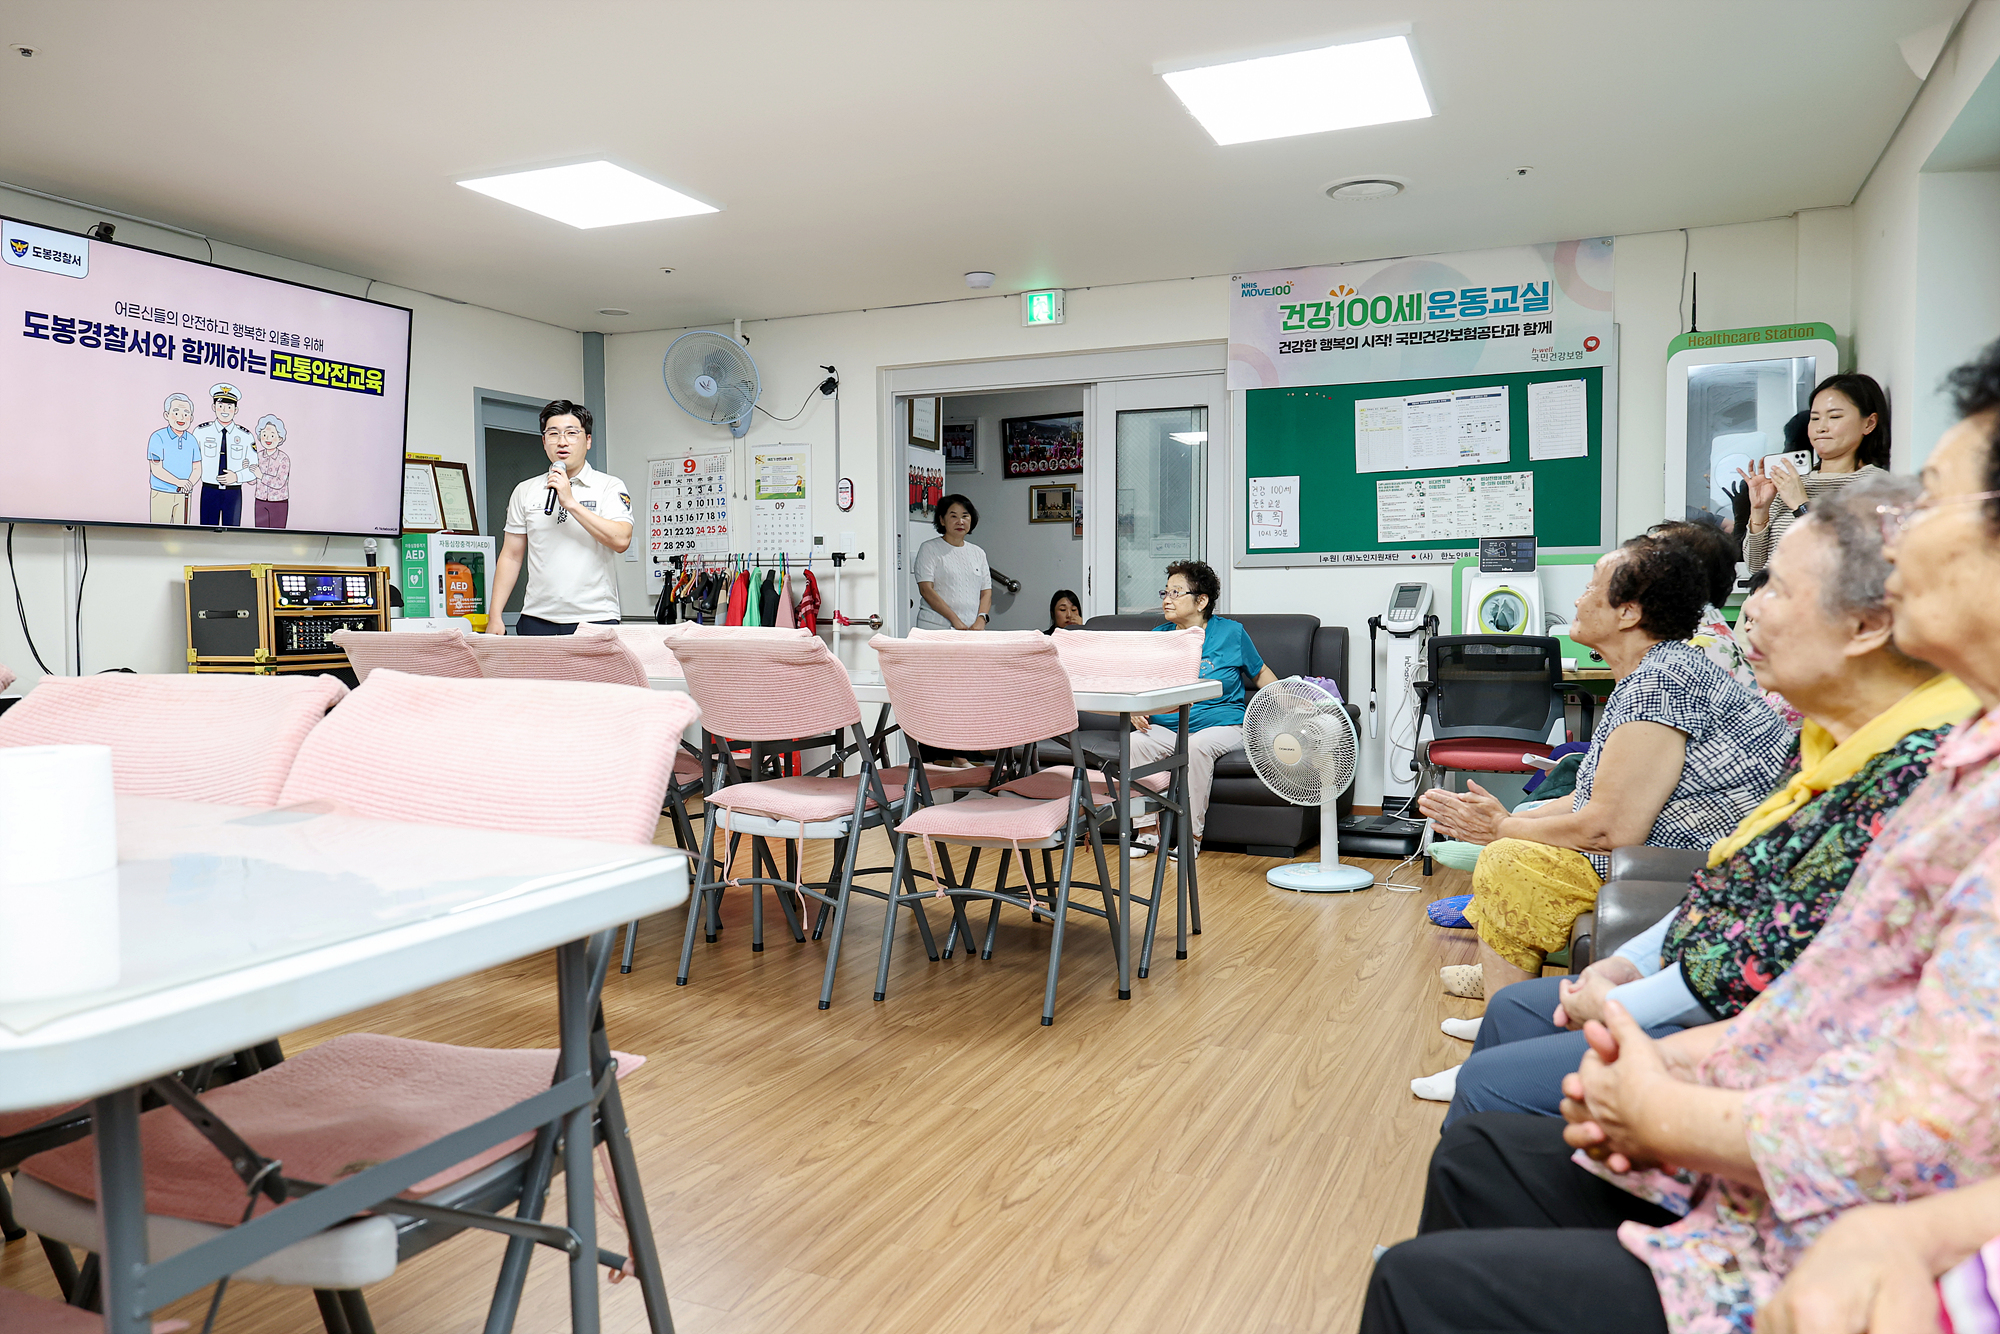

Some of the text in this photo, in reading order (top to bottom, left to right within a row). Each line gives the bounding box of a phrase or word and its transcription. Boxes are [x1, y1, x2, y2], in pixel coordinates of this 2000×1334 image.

[32, 246, 81, 266] 도봉경찰서
[1280, 281, 1549, 331] 건강100세 운동교실
[115, 301, 324, 352] 어르신들의 안전하고 행복한 외출을 위해
[1279, 321, 1552, 354] 건강한 행복의 시작! 국민건강보험공단과 함께
[1688, 327, 1814, 347] Healthcare Station
[23, 310, 383, 393] 도봉경찰서와 함께하는 교통안전교육
[1531, 350, 1583, 362] 국민건강보험
[683, 459, 696, 473] 9
[1252, 486, 1265, 496] 건강
[1253, 499, 1280, 508] 운동 교실
[1256, 511, 1280, 523] 월 목
[1274, 529, 1288, 537] 30분
[439, 540, 490, 549] 자동심장충격기(AED)
[406, 550, 425, 559] AED
[450, 582, 468, 590] AED
